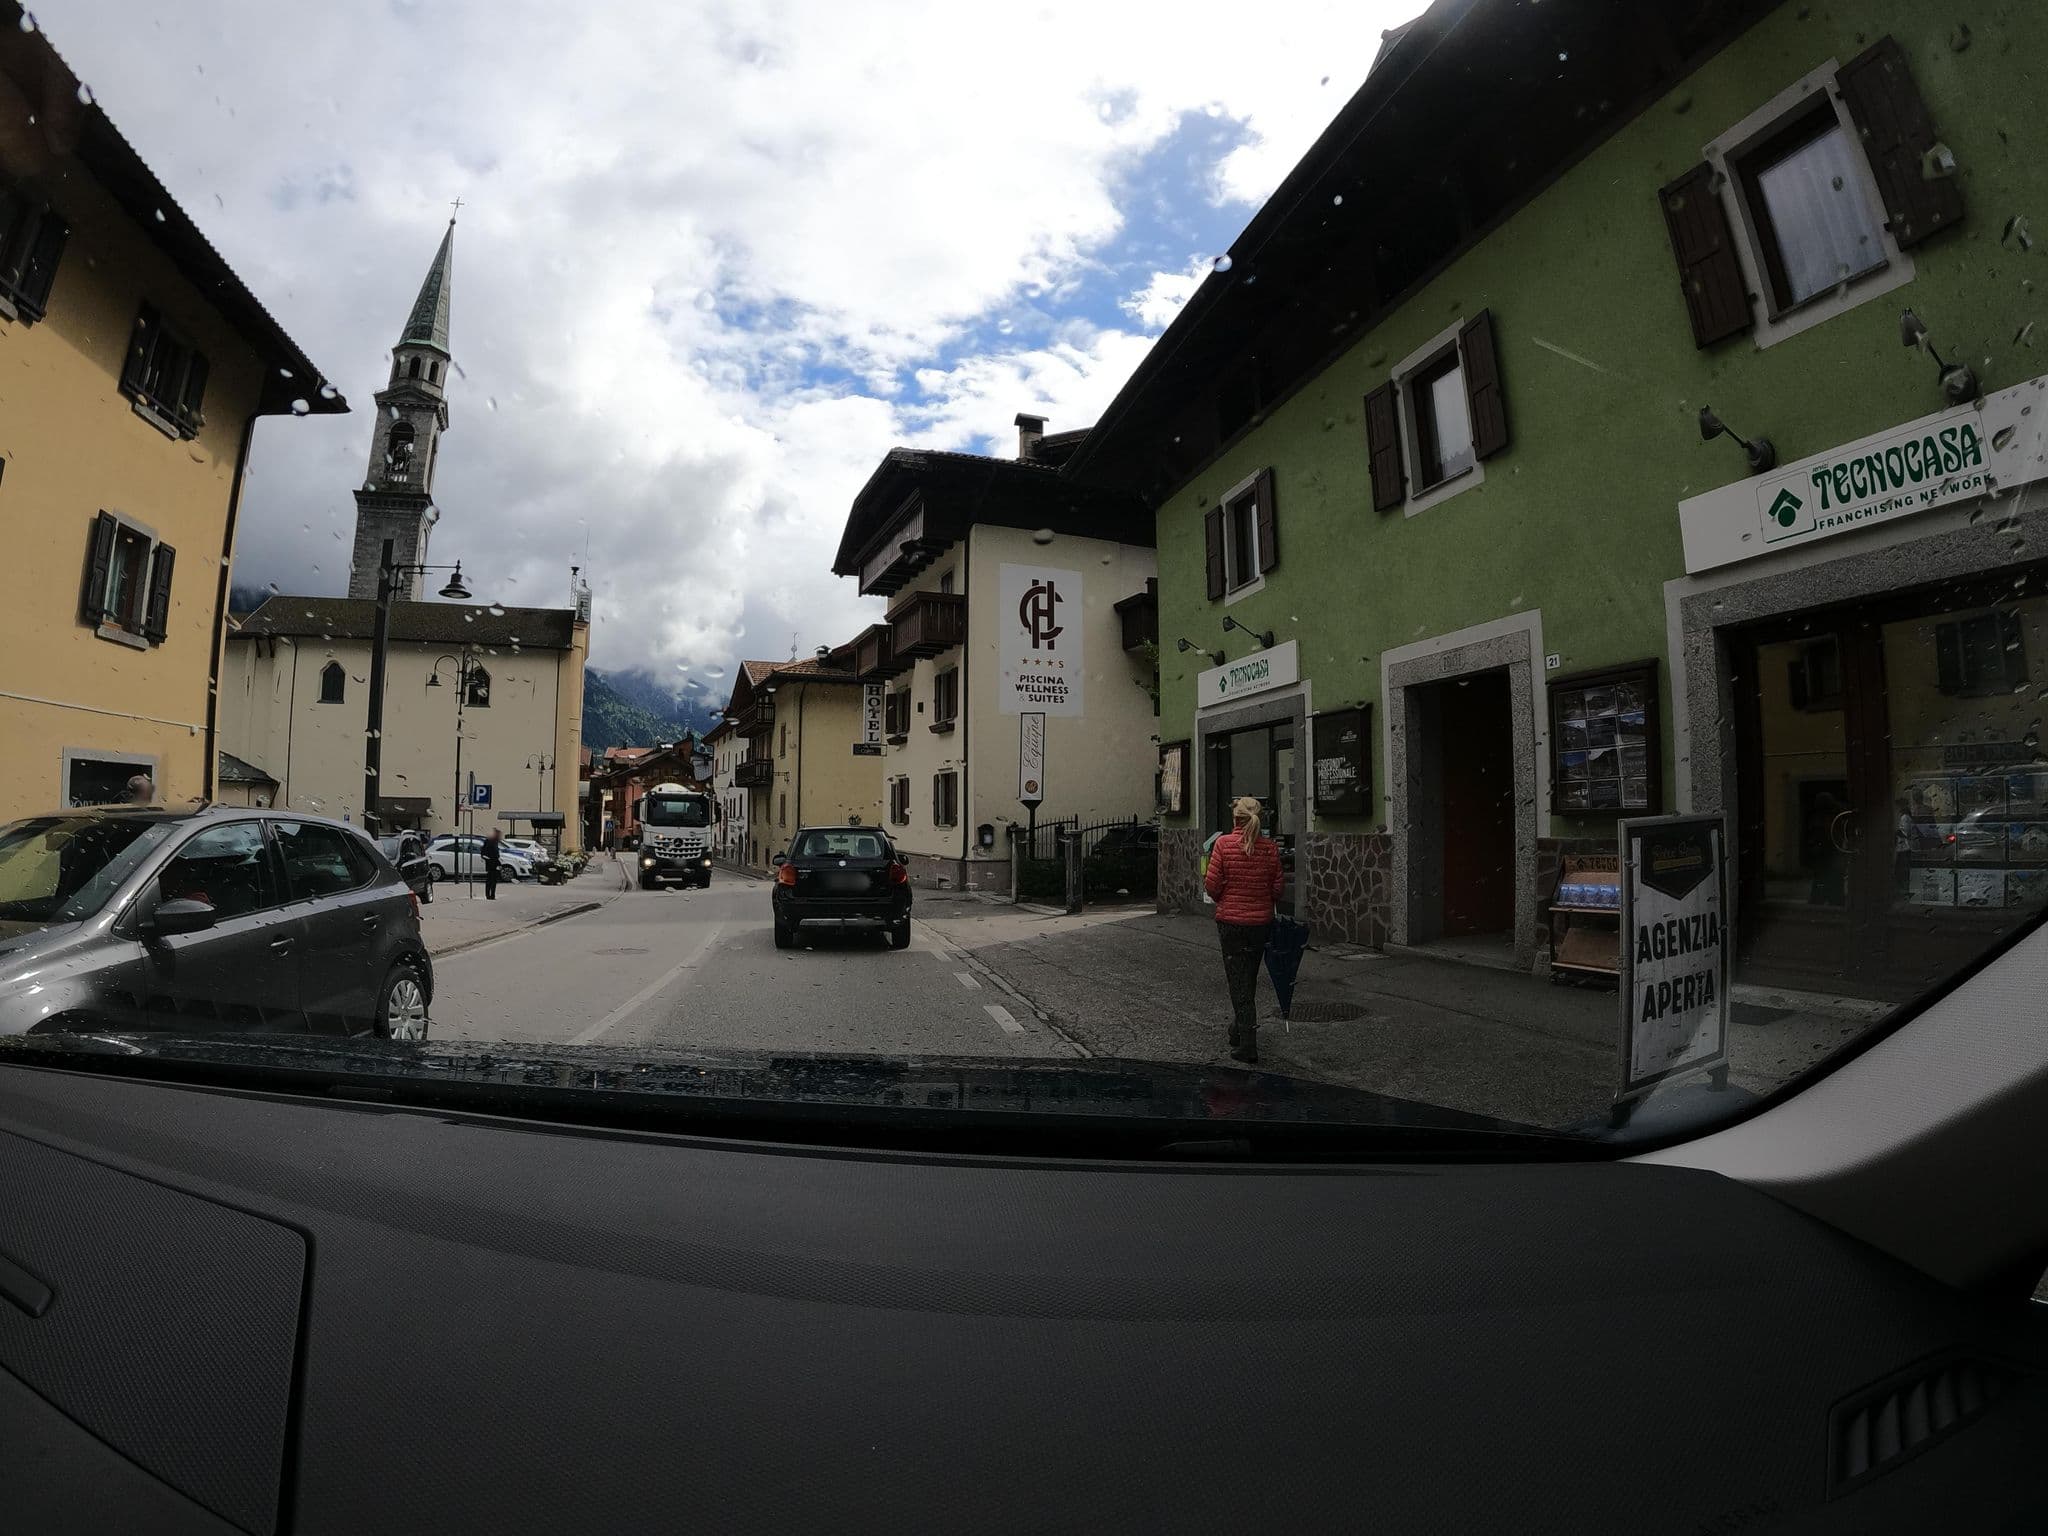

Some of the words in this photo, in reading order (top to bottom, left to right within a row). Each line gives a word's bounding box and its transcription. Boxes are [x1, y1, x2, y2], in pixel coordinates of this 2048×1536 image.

[1812, 424, 1982, 510] TECNOCASA
[1919, 473, 1991, 503] NEWORK
[1229, 658, 1269, 687] TECNOCASA
[1548, 657, 1558, 667] 21
[1015, 684, 1069, 695] WELLNESS
[1019, 674, 1065, 685] PISCINA
[867, 685, 881, 742] HOTEL
[1028, 695, 1065, 704] SUITES
[476, 786, 487, 801] P
[1636, 911, 1720, 964] AGENZIA
[1641, 969, 1715, 1023] APERTA
